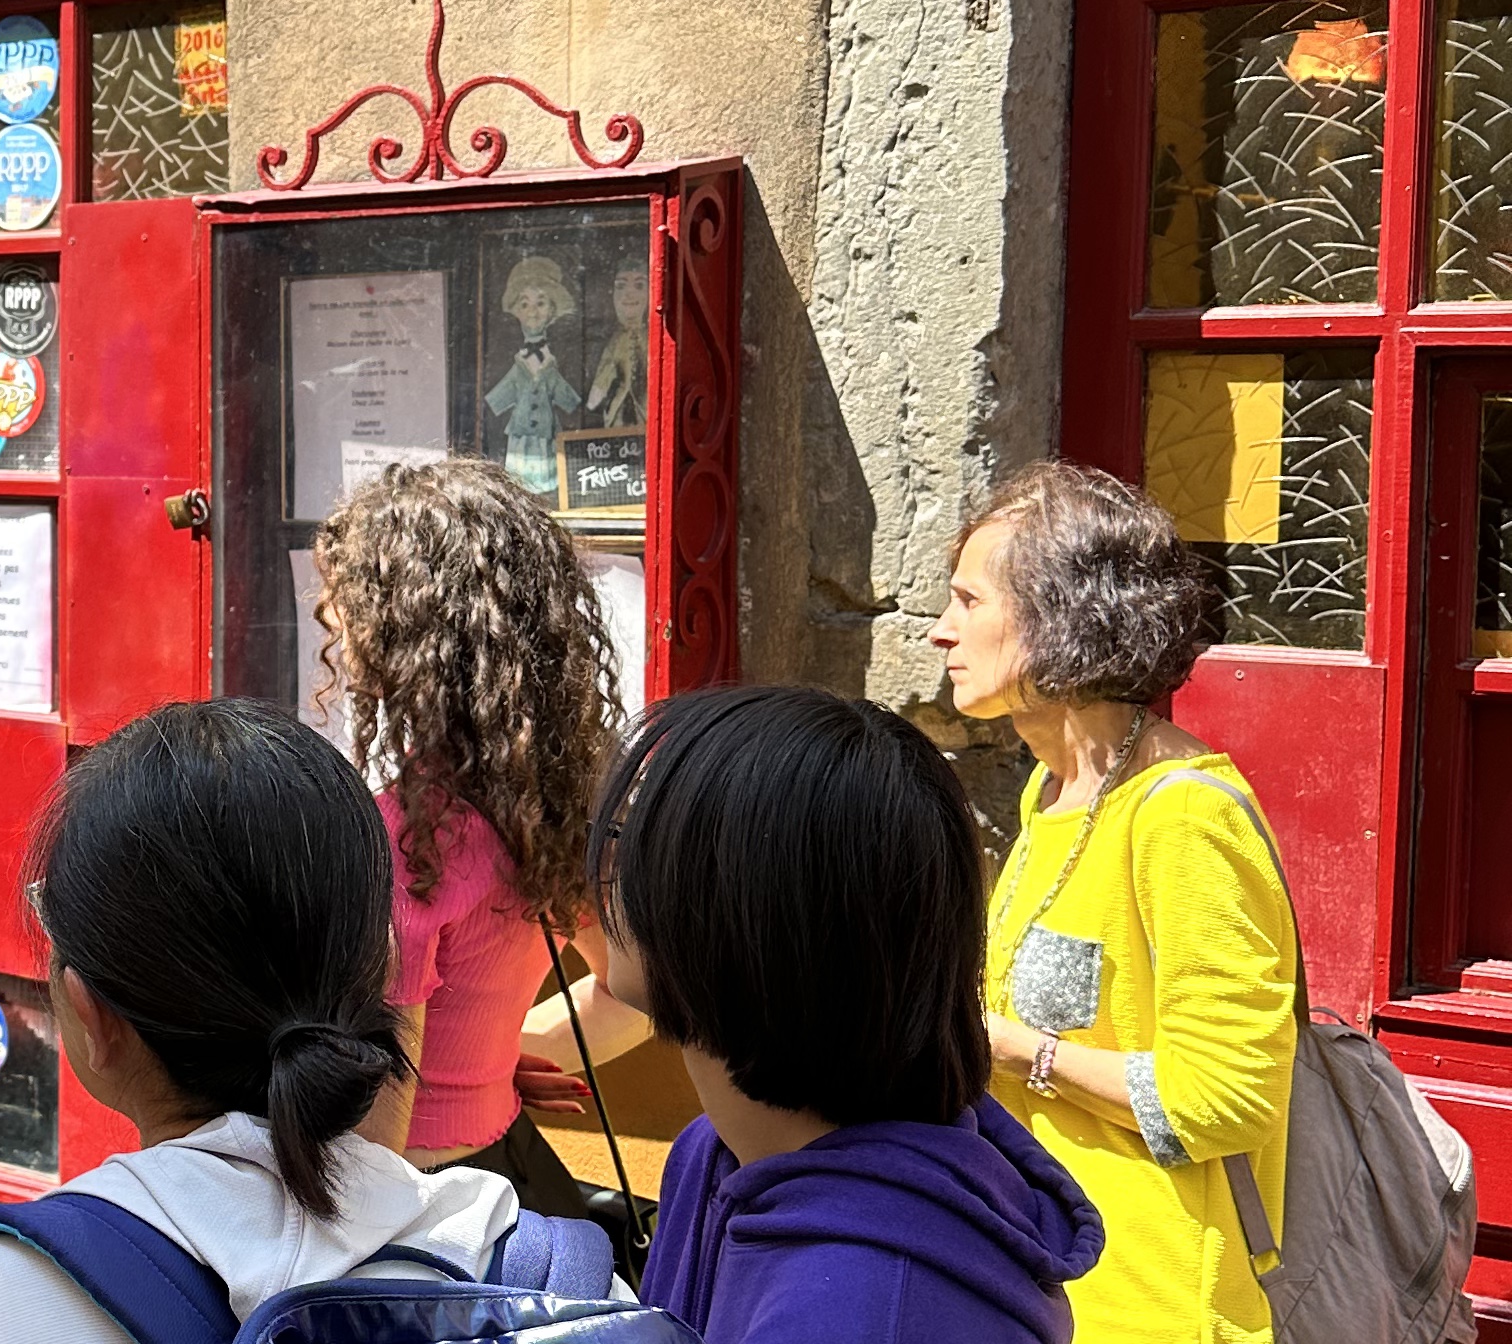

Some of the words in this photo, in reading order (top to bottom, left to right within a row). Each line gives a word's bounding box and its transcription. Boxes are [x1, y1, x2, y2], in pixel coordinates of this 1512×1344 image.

[182, 28, 224, 54] 2016
[4, 286, 42, 311] RPPP
[619, 441, 642, 458] de
[626, 472, 647, 497] ici
[4, 565, 19, 575] pas
